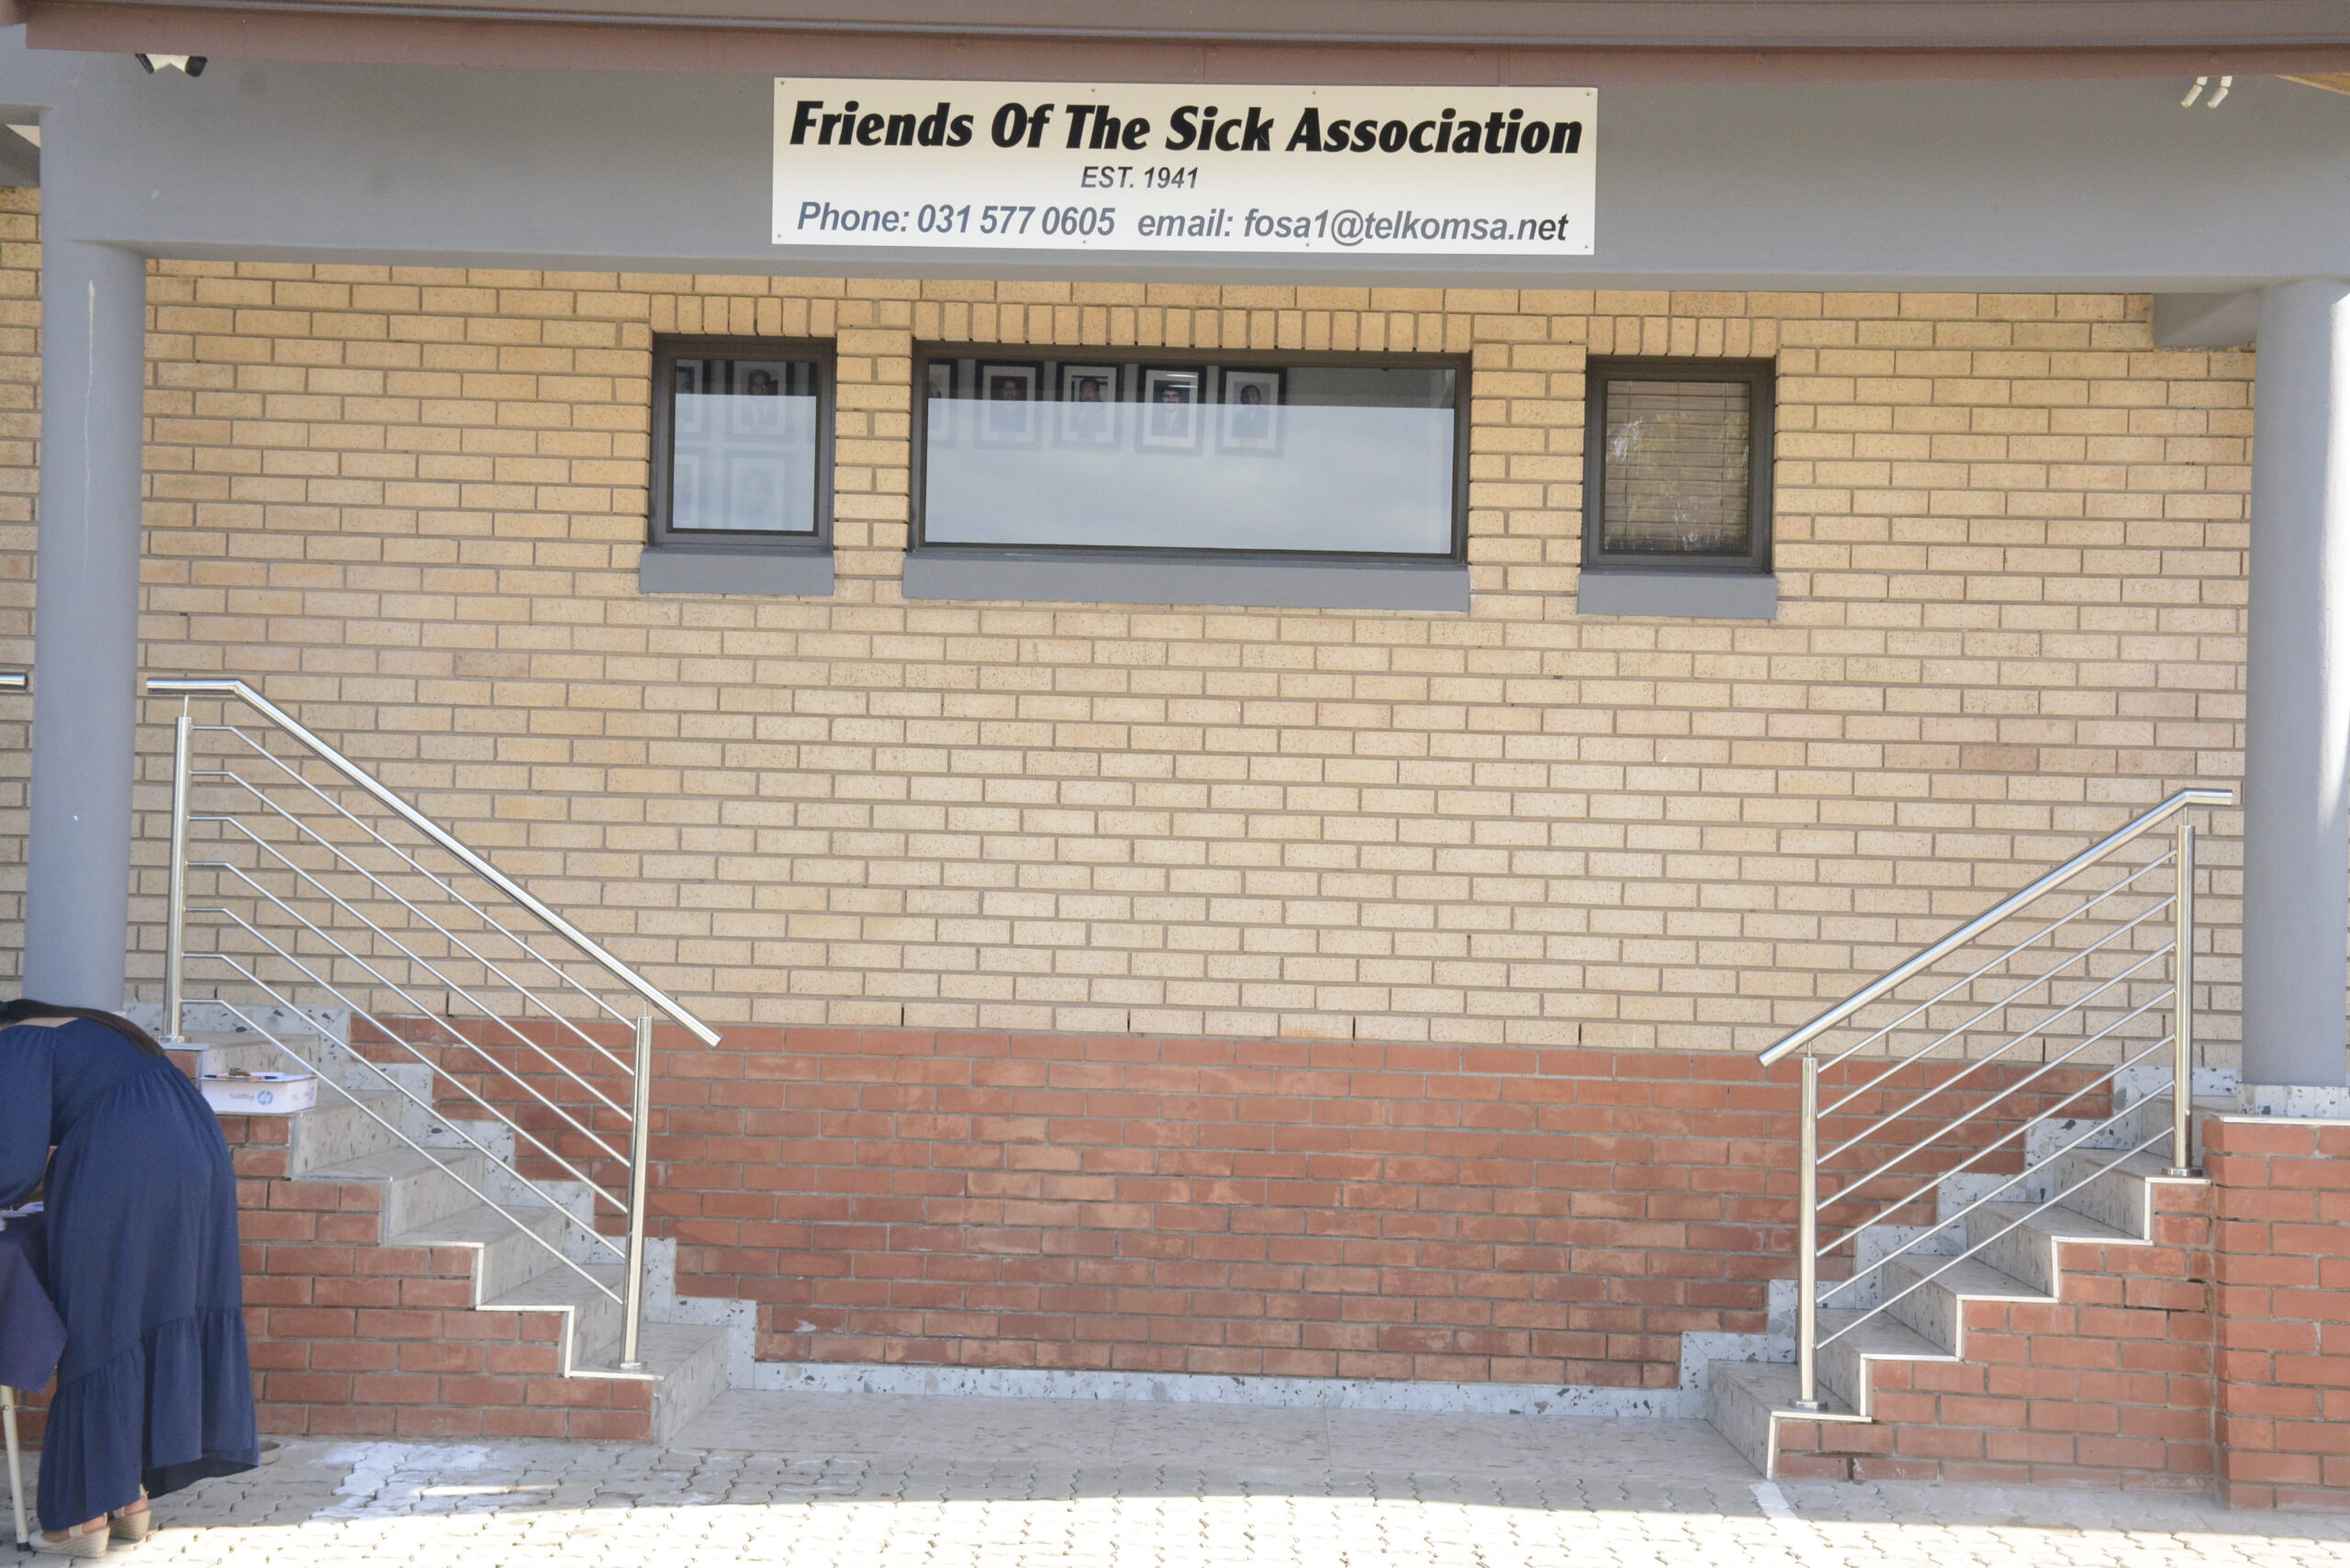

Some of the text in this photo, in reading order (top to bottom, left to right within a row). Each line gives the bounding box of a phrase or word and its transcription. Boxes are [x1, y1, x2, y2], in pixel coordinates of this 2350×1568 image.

[789, 99, 1583, 155] Friends Of The Sick Association
[1080, 165, 1199, 189] EST. 1941
[797, 201, 1570, 247] Phone: 031 577 0605 email: fosa1@telkomsa.net
